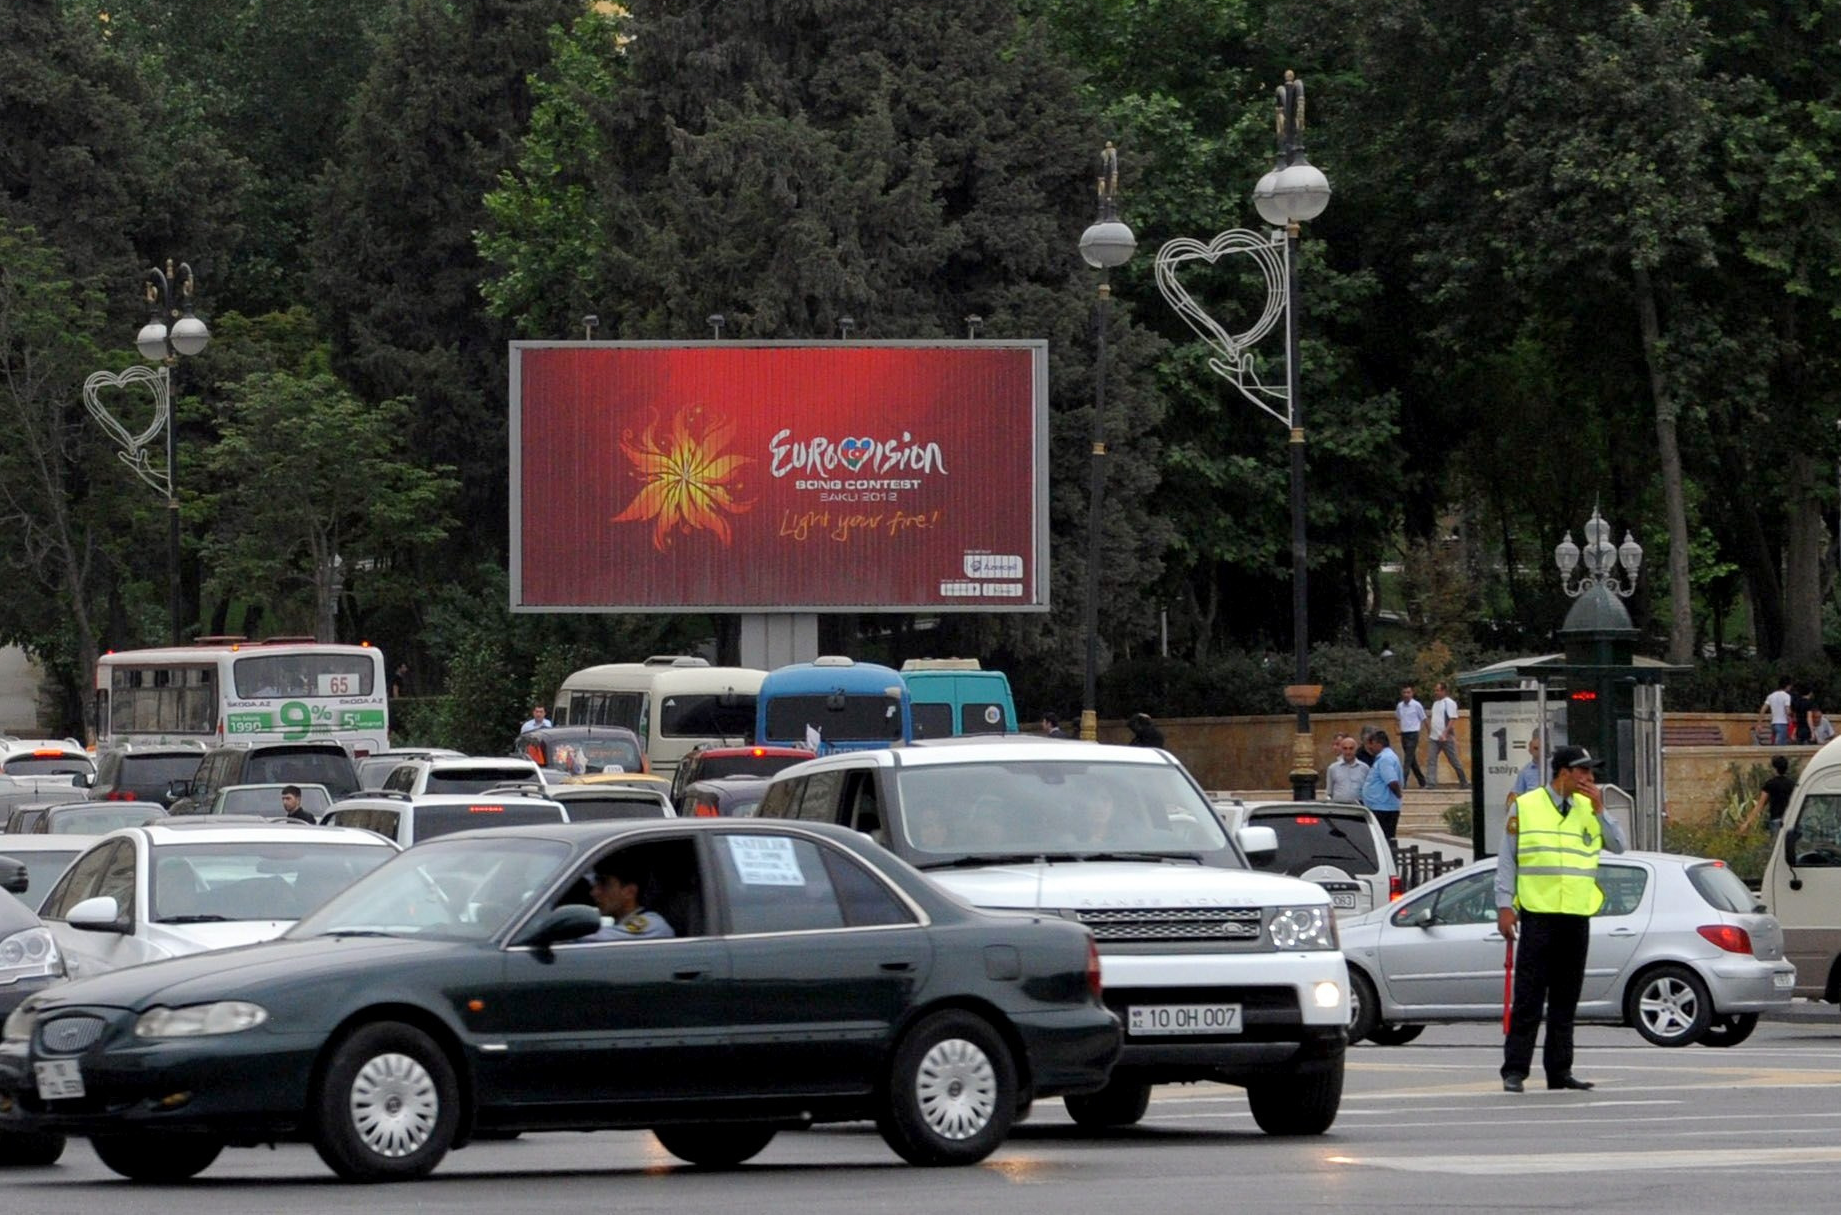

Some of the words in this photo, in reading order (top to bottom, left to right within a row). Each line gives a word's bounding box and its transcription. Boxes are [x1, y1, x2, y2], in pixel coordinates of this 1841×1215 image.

[795, 480, 842, 490] SONG
[845, 480, 922, 490] CONTEST
[820, 492, 858, 502] BAKU
[862, 492, 898, 502] 2012
[779, 509, 830, 541] Light
[831, 513, 884, 542] your
[887, 511, 941, 535] fire!
[330, 676, 348, 694] 65
[1492, 727, 1508, 761] 1
[1150, 1009, 1170, 1027] 10
[1203, 1007, 1237, 1027] 007
